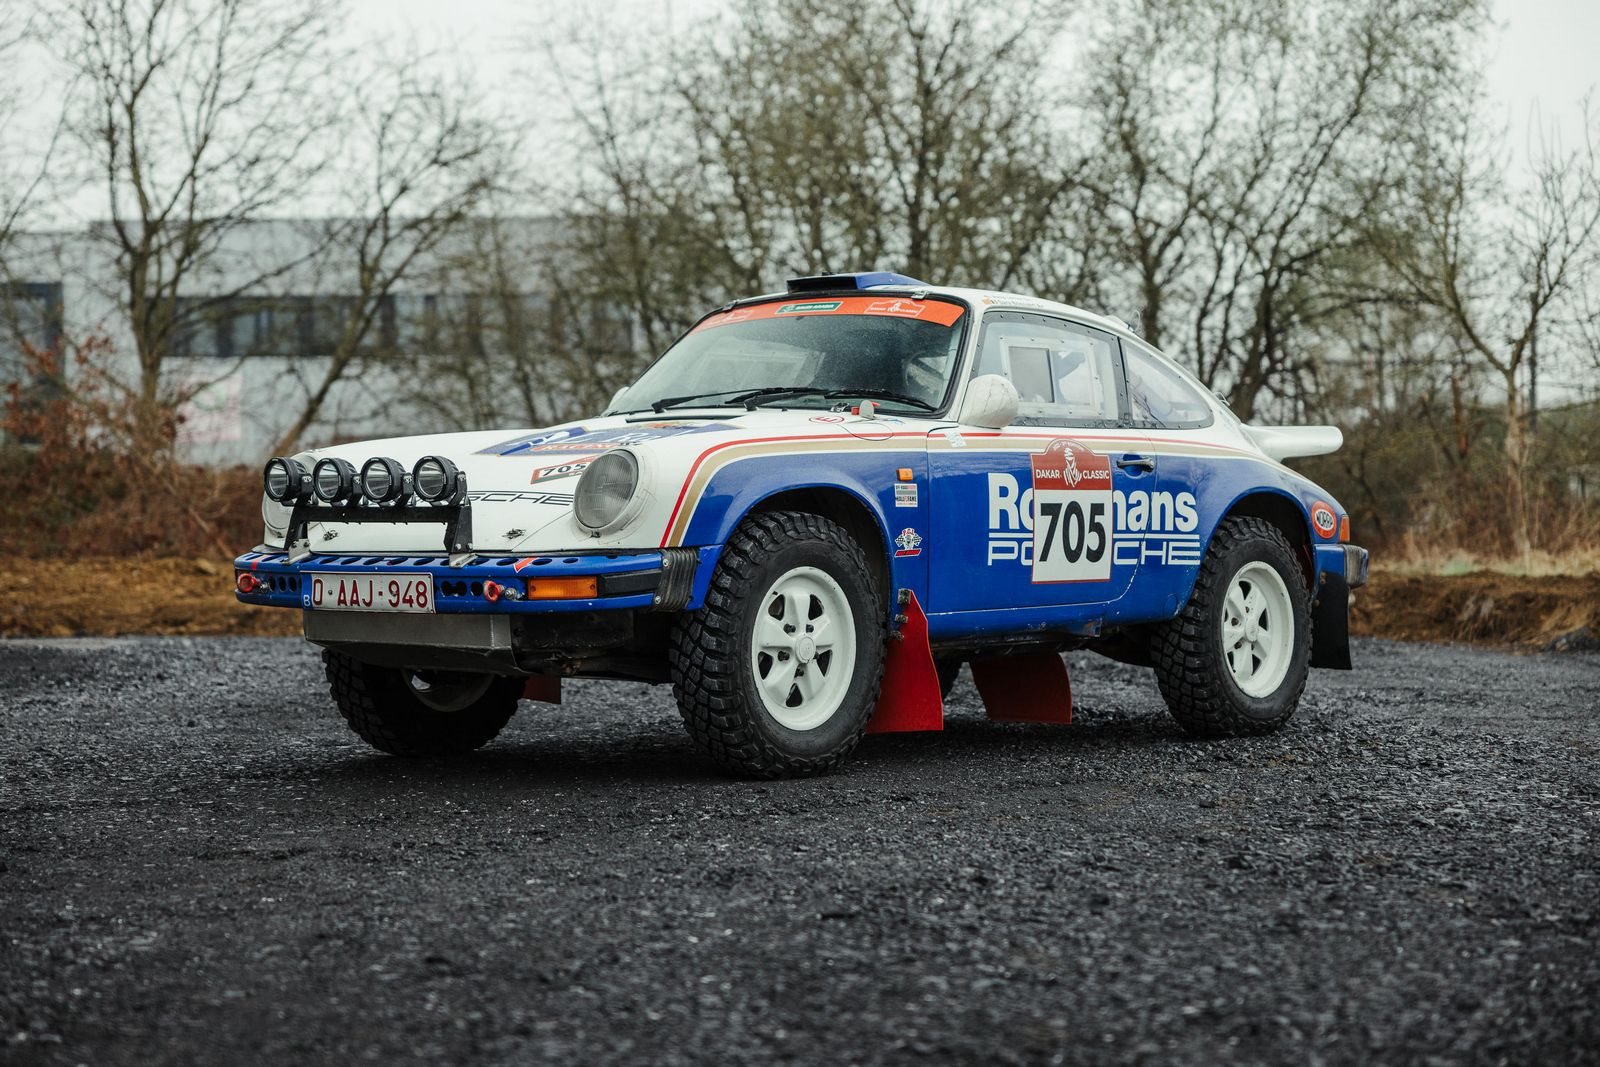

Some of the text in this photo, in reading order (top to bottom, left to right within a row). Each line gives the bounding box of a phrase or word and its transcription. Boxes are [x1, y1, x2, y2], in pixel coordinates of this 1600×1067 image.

[543, 462, 586, 477] 705
[1036, 469, 1110, 480] DAKAR CLASSIC
[1039, 500, 1107, 563] 705
